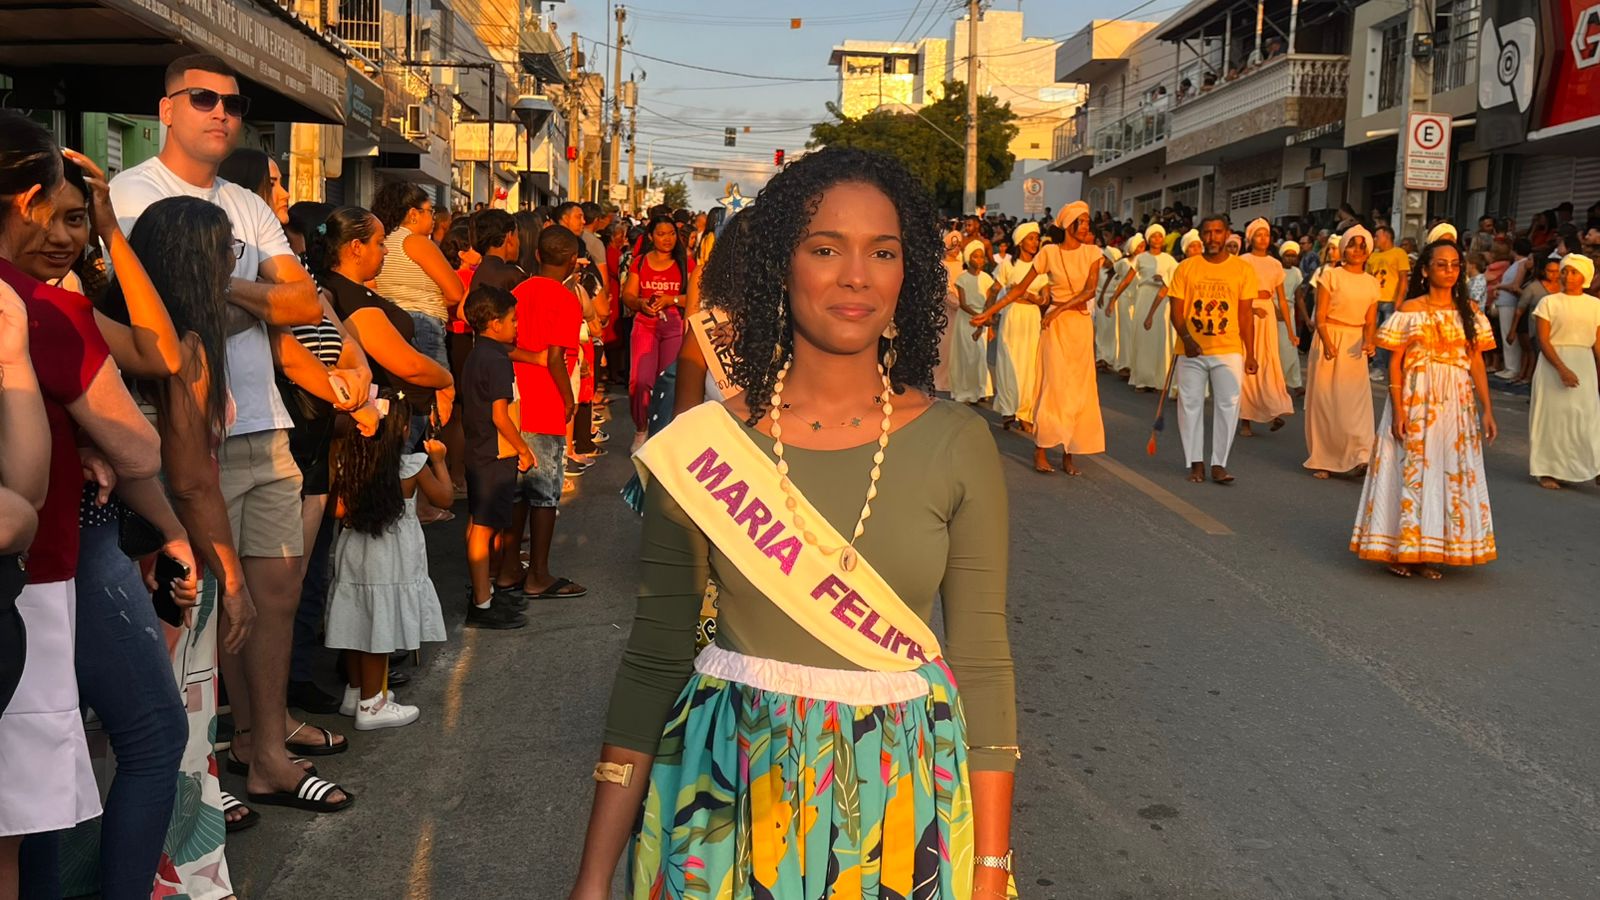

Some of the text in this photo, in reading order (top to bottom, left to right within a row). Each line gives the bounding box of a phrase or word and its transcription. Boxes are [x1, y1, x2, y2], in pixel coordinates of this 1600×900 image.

[217, 0, 236, 34] VOCÊ
[237, 9, 253, 44] VIVE
[254, 20, 270, 55] UMA
[1424, 126, 1434, 142] E
[640, 280, 681, 291] LACOSTE
[686, 447, 931, 664] MARIA FELIPA
